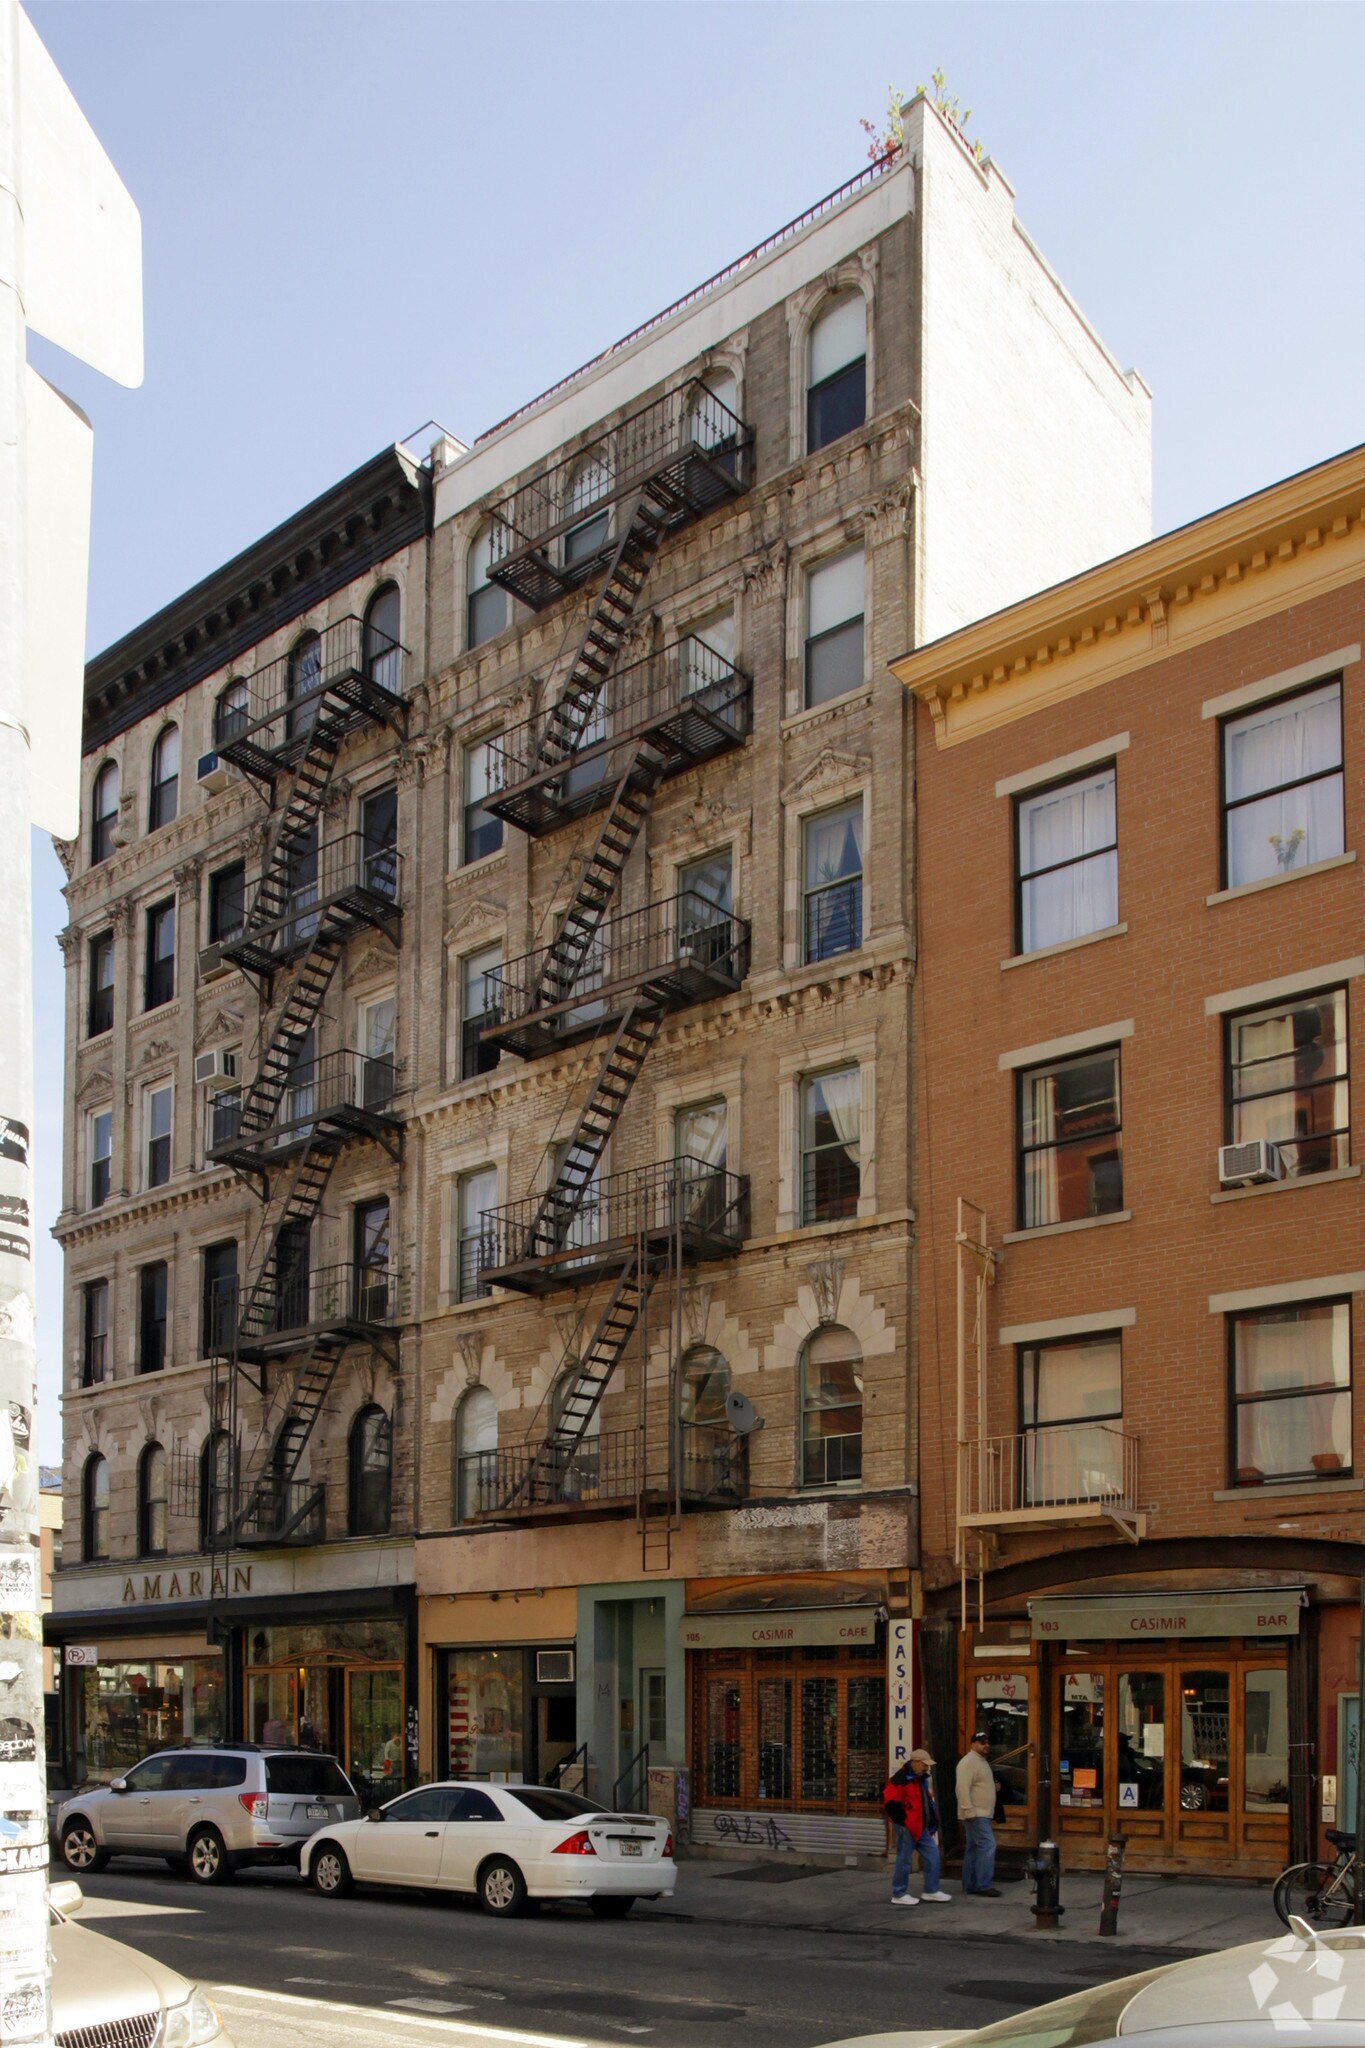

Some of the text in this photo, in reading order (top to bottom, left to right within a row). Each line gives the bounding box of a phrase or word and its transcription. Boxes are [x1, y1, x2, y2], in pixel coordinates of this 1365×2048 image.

[122, 1565, 253, 1602] AMARAN
[1040, 1621, 1060, 1632] 103
[1257, 1615, 1289, 1627] BAR
[685, 1633, 701, 1642] 105
[839, 1626, 868, 1638] CAFE
[1123, 1787, 1135, 1800] A
